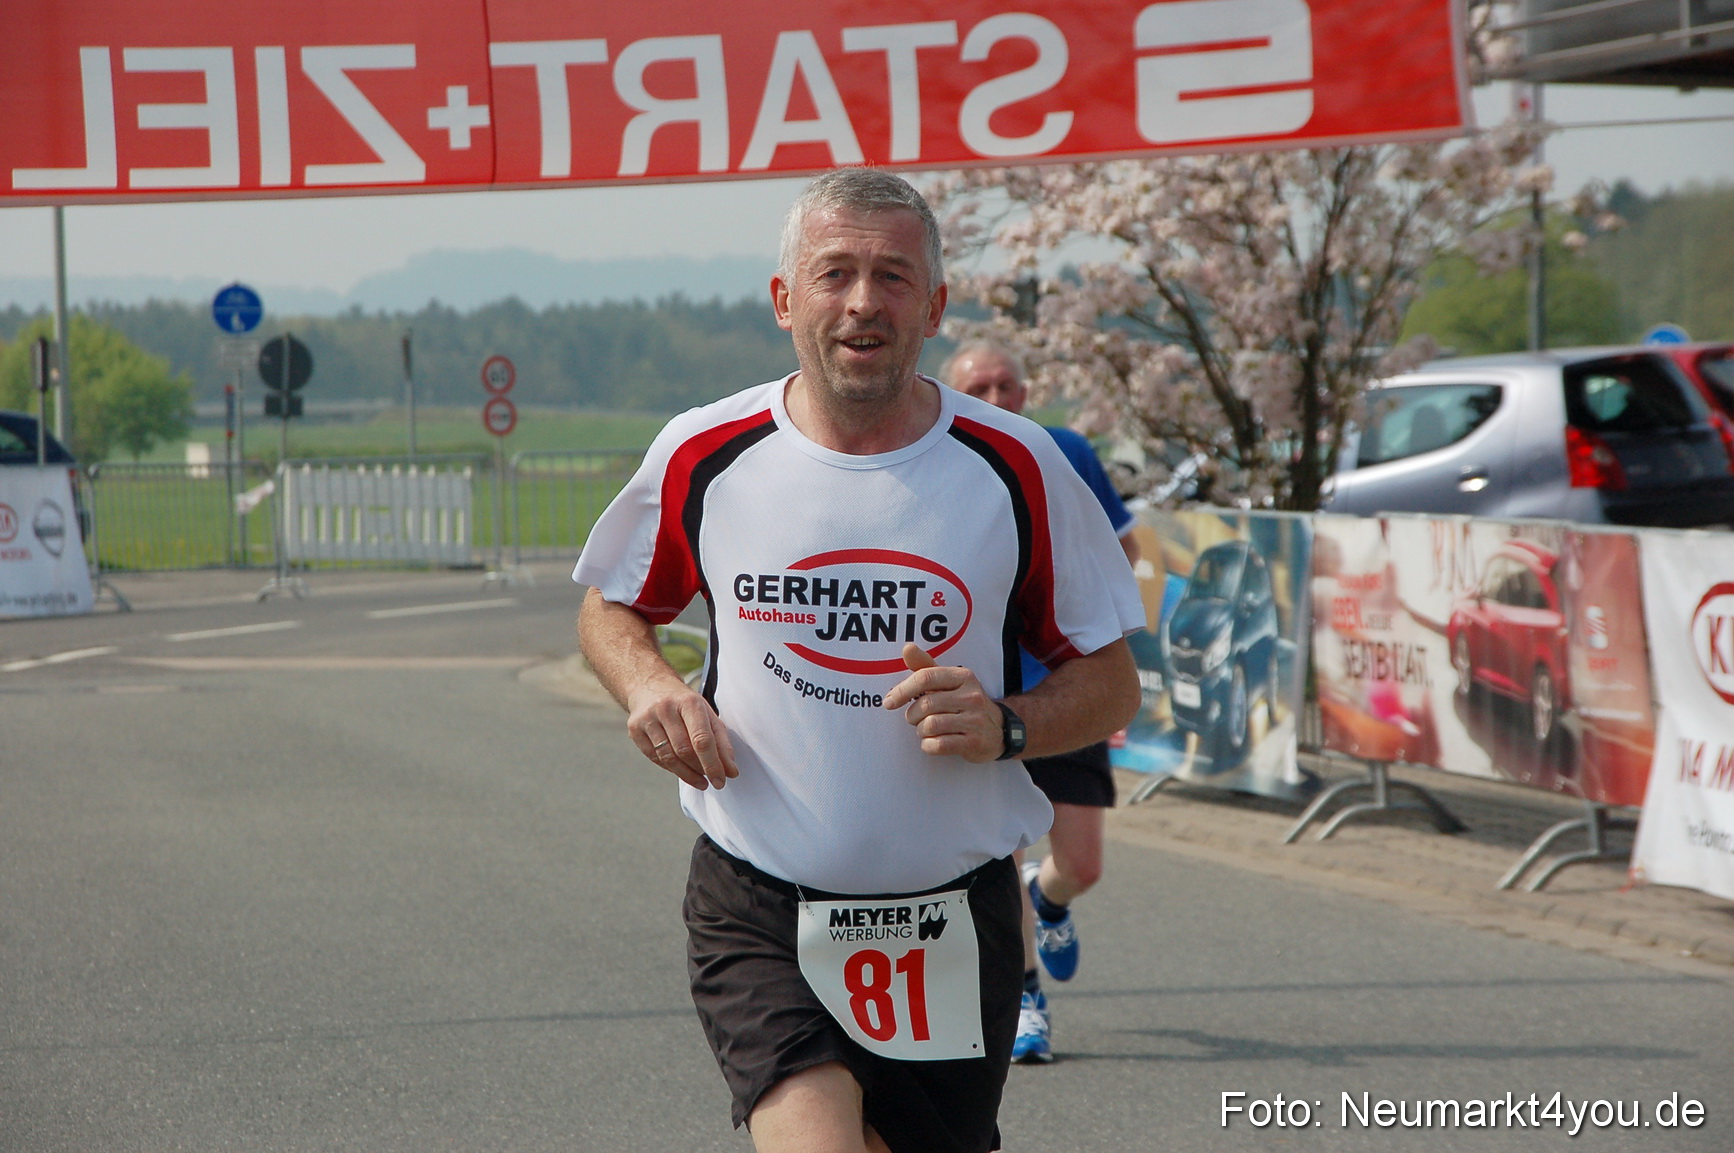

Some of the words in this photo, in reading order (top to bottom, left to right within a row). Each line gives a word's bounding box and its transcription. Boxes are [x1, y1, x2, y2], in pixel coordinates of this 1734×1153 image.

[733, 573, 926, 609] GERHART
[930, 591, 947, 607] &
[738, 606, 817, 625] Autohaus
[815, 611, 949, 643] JÄNIG
[762, 652, 792, 684] Das
[793, 676, 884, 709] sportliche
[828, 906, 913, 928] MEYER
[828, 926, 913, 942] WERBUNG
[843, 948, 931, 1042] 81
